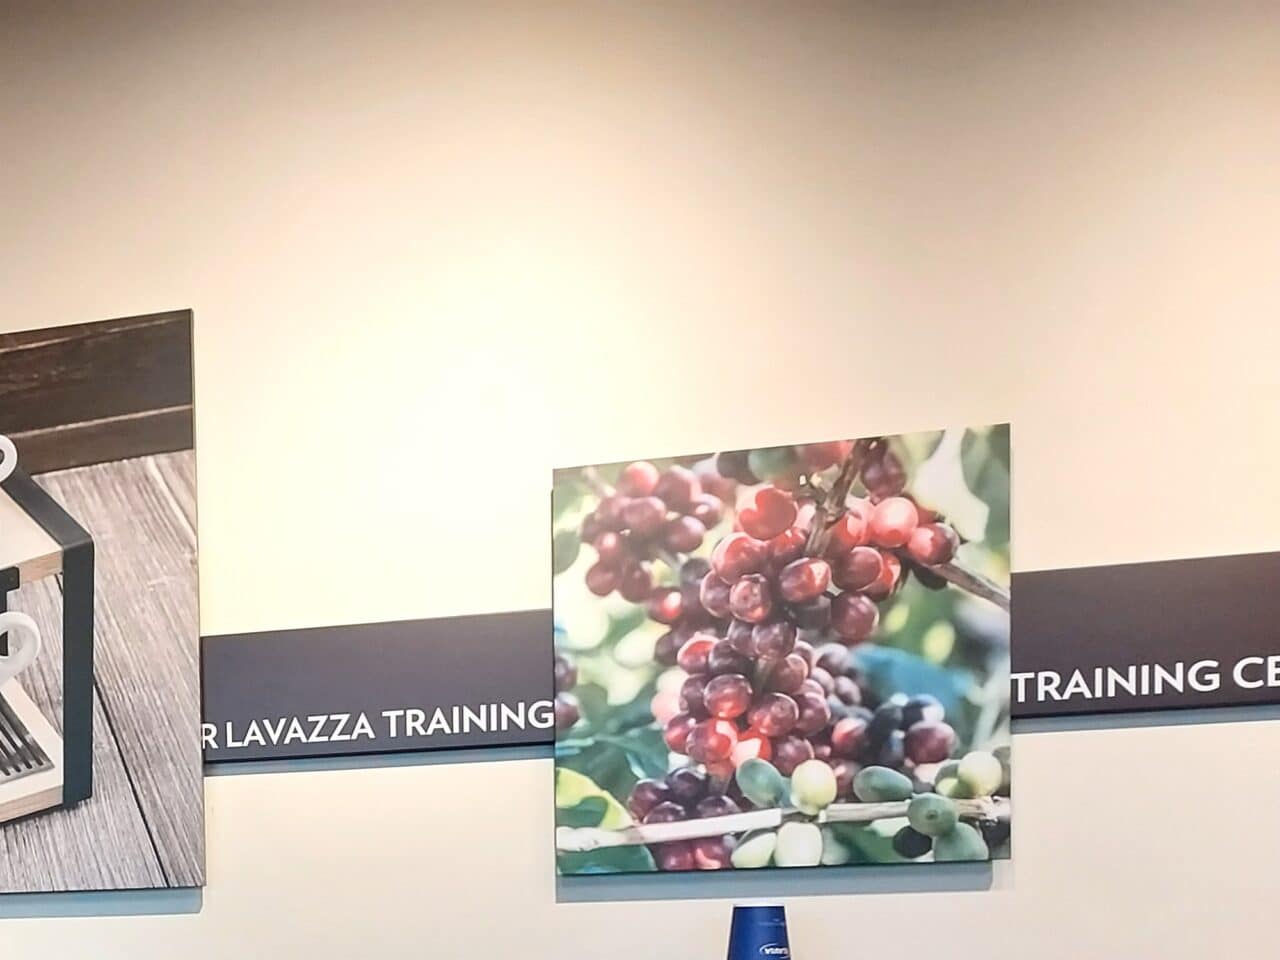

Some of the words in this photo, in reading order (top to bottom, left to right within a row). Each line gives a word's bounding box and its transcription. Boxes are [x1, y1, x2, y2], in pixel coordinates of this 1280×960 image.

[1010, 659, 1221, 703] TRAINING
[225, 713, 376, 749] LAVAZZA
[381, 700, 554, 738] TRAINING
